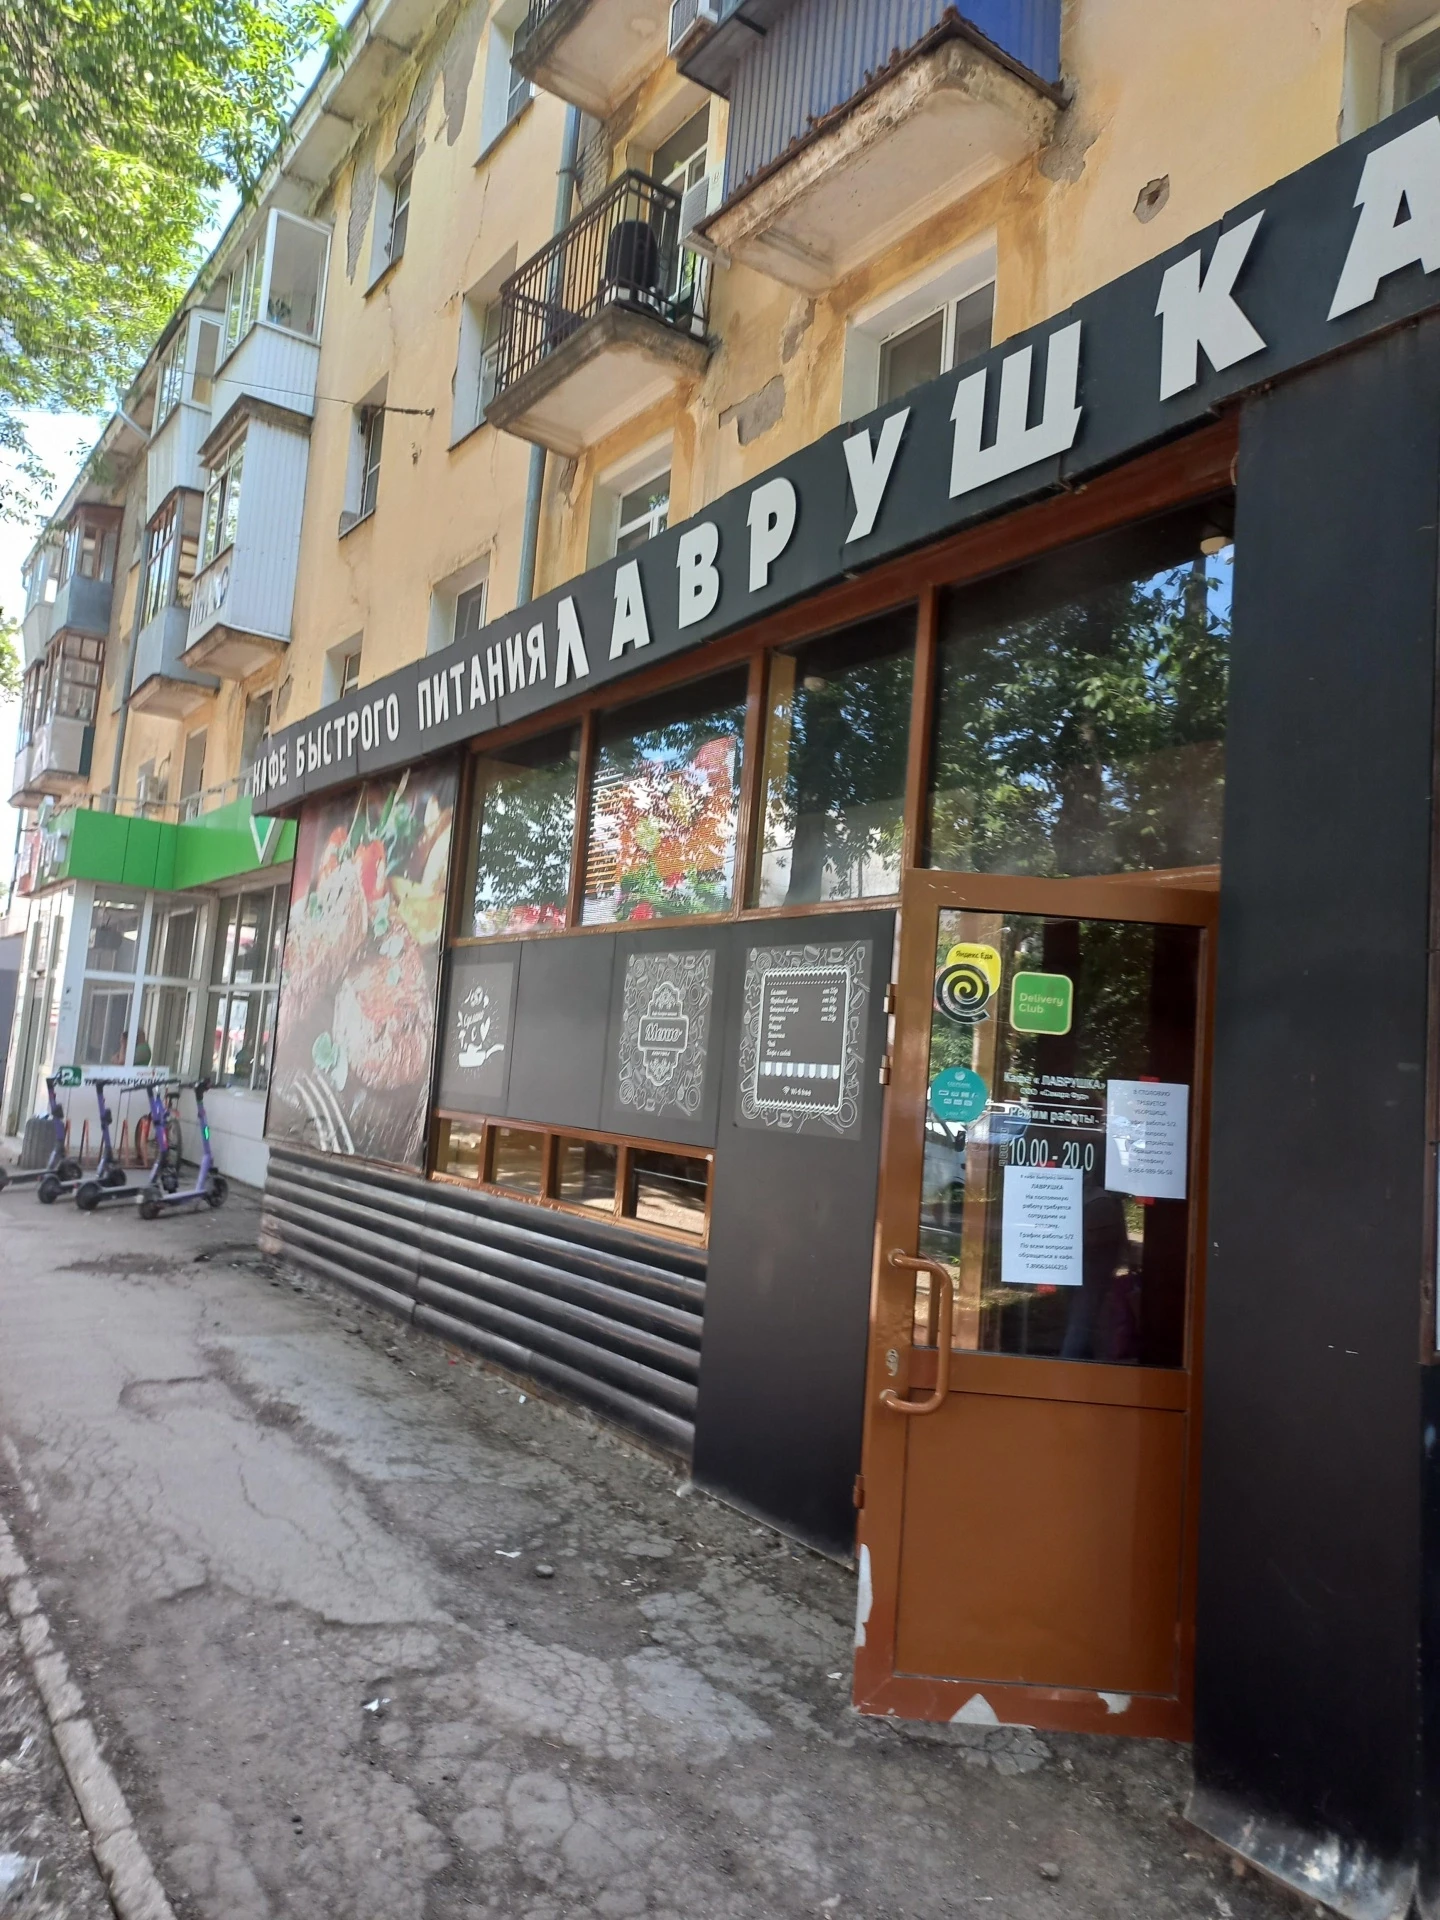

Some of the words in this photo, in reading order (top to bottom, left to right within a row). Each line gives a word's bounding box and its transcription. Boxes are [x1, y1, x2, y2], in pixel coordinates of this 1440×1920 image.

[554, 114, 1440, 689] ЛАВРУШКА
[252, 740, 289, 798] КАФЕ
[295, 692, 400, 778] БЫСТРОГО
[417, 622, 547, 731] ПИТАНИЯ
[1019, 992, 1064, 1007] Delivery
[1018, 1003, 1044, 1014] Club
[1004, 1071, 1032, 1084] Кафе
[1010, 1105, 1049, 1121] Режим
[1009, 1138, 1049, 1167] 10.00
